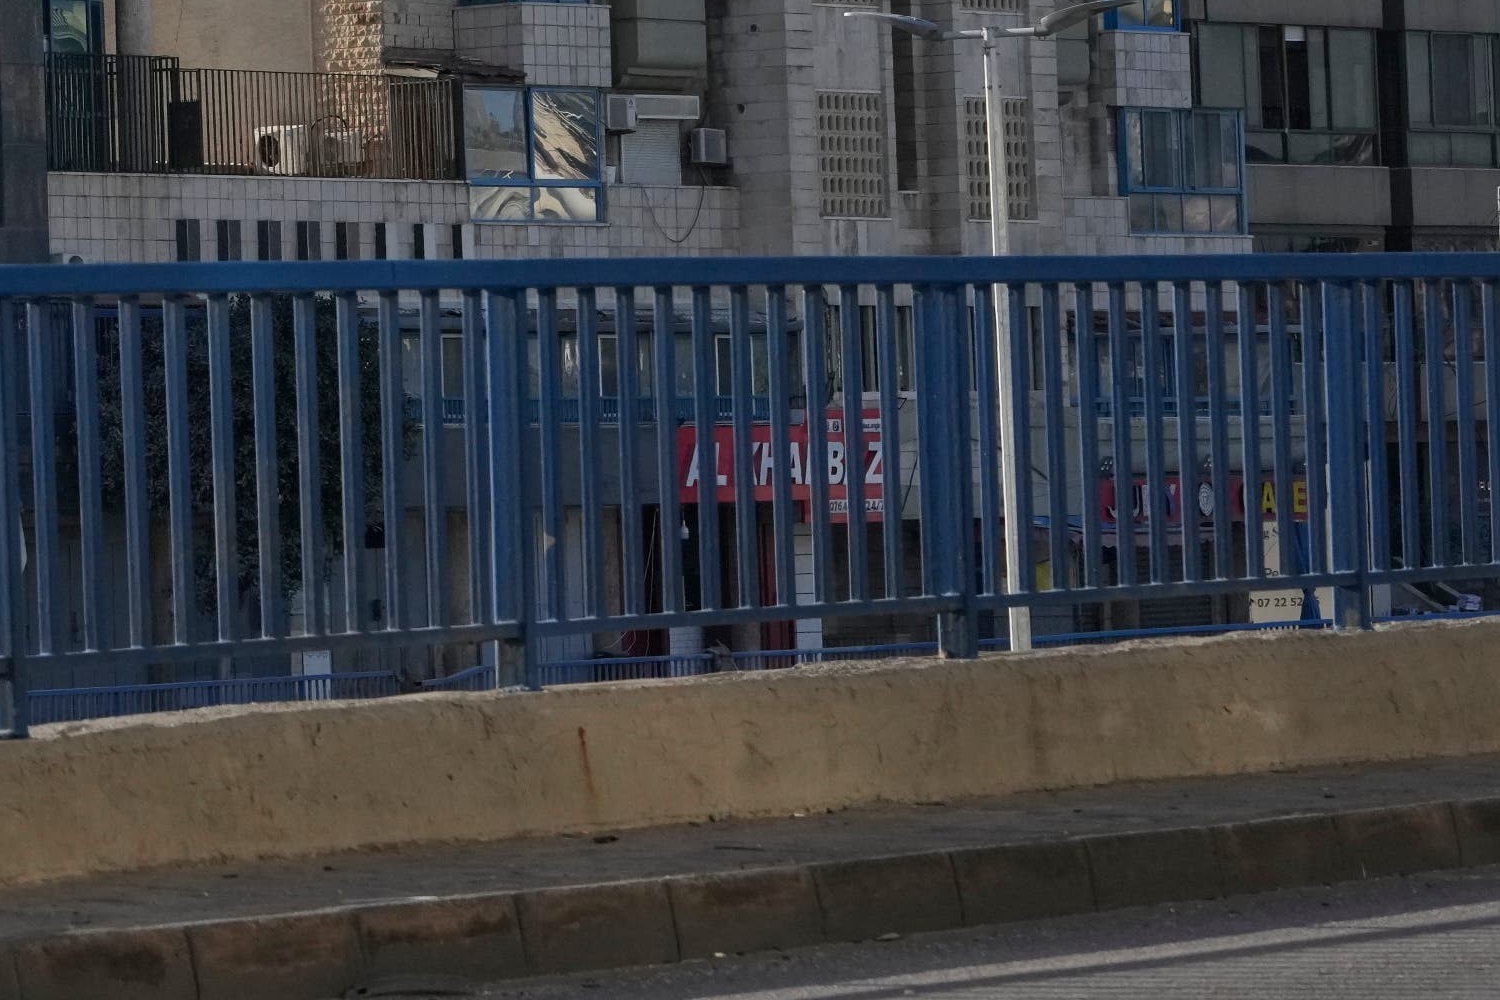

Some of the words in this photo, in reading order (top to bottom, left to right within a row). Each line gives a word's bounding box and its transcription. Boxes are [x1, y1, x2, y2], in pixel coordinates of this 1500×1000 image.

[751, 441, 884, 486] KHABZ
[1257, 598, 1270, 608] 07
[1274, 597, 1287, 607] 22
